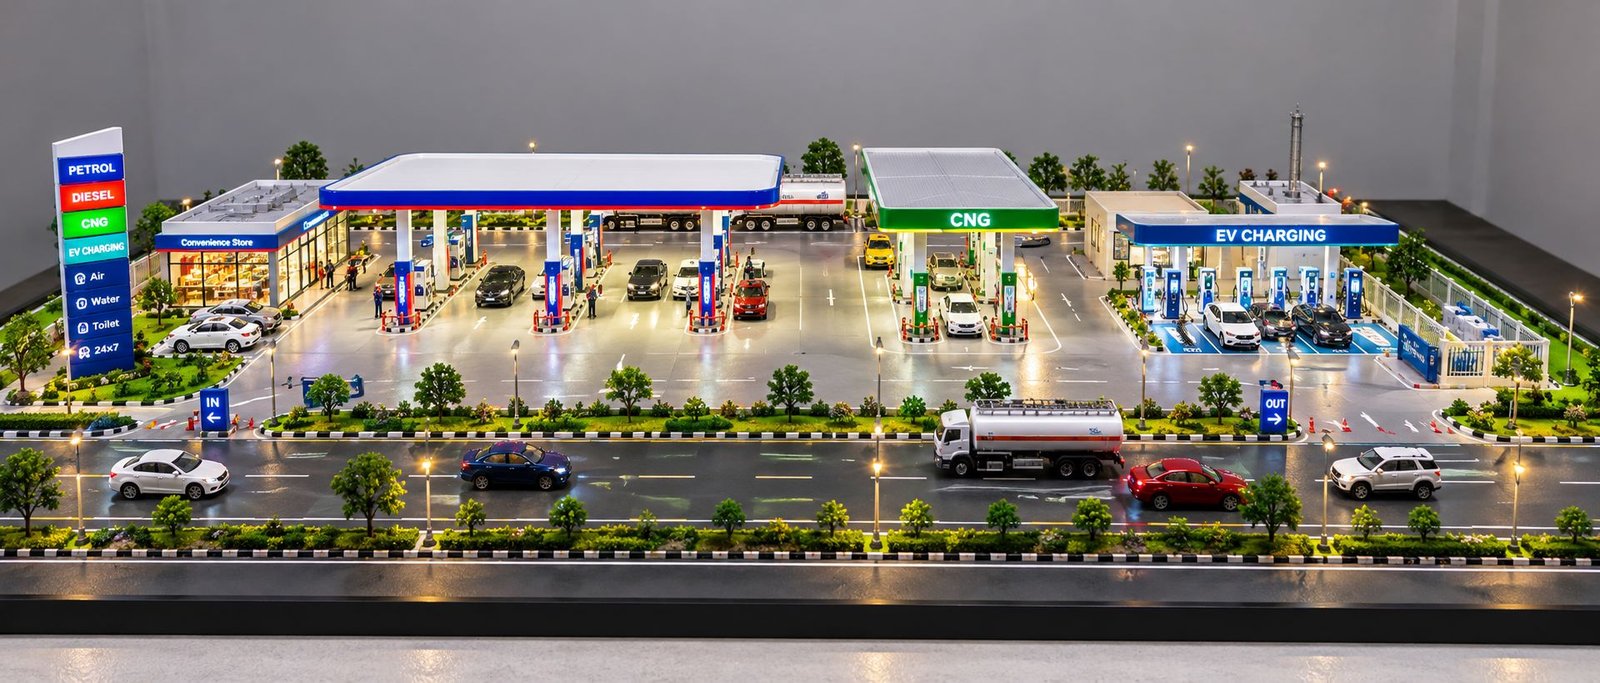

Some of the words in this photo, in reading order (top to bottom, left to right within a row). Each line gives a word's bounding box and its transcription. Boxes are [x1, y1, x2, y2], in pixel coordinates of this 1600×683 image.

[69, 163, 116, 176] PETROL
[72, 190, 115, 203] DIESEL
[81, 217, 108, 229] CNG
[950, 212, 991, 227] CNG
[1216, 229, 1238, 242] EV
[1241, 229, 1327, 242] CHARGING
[181, 238, 231, 247] Convenience
[232, 238, 254, 247] Store
[69, 247, 81, 257] EV
[82, 242, 125, 255] CHARGING
[90, 271, 105, 281] Air
[91, 295, 120, 306] Water
[93, 319, 120, 331] Toilet
[94, 343, 119, 355] 24x7
[206, 397, 220, 408] IN
[1265, 398, 1287, 409] OUT
